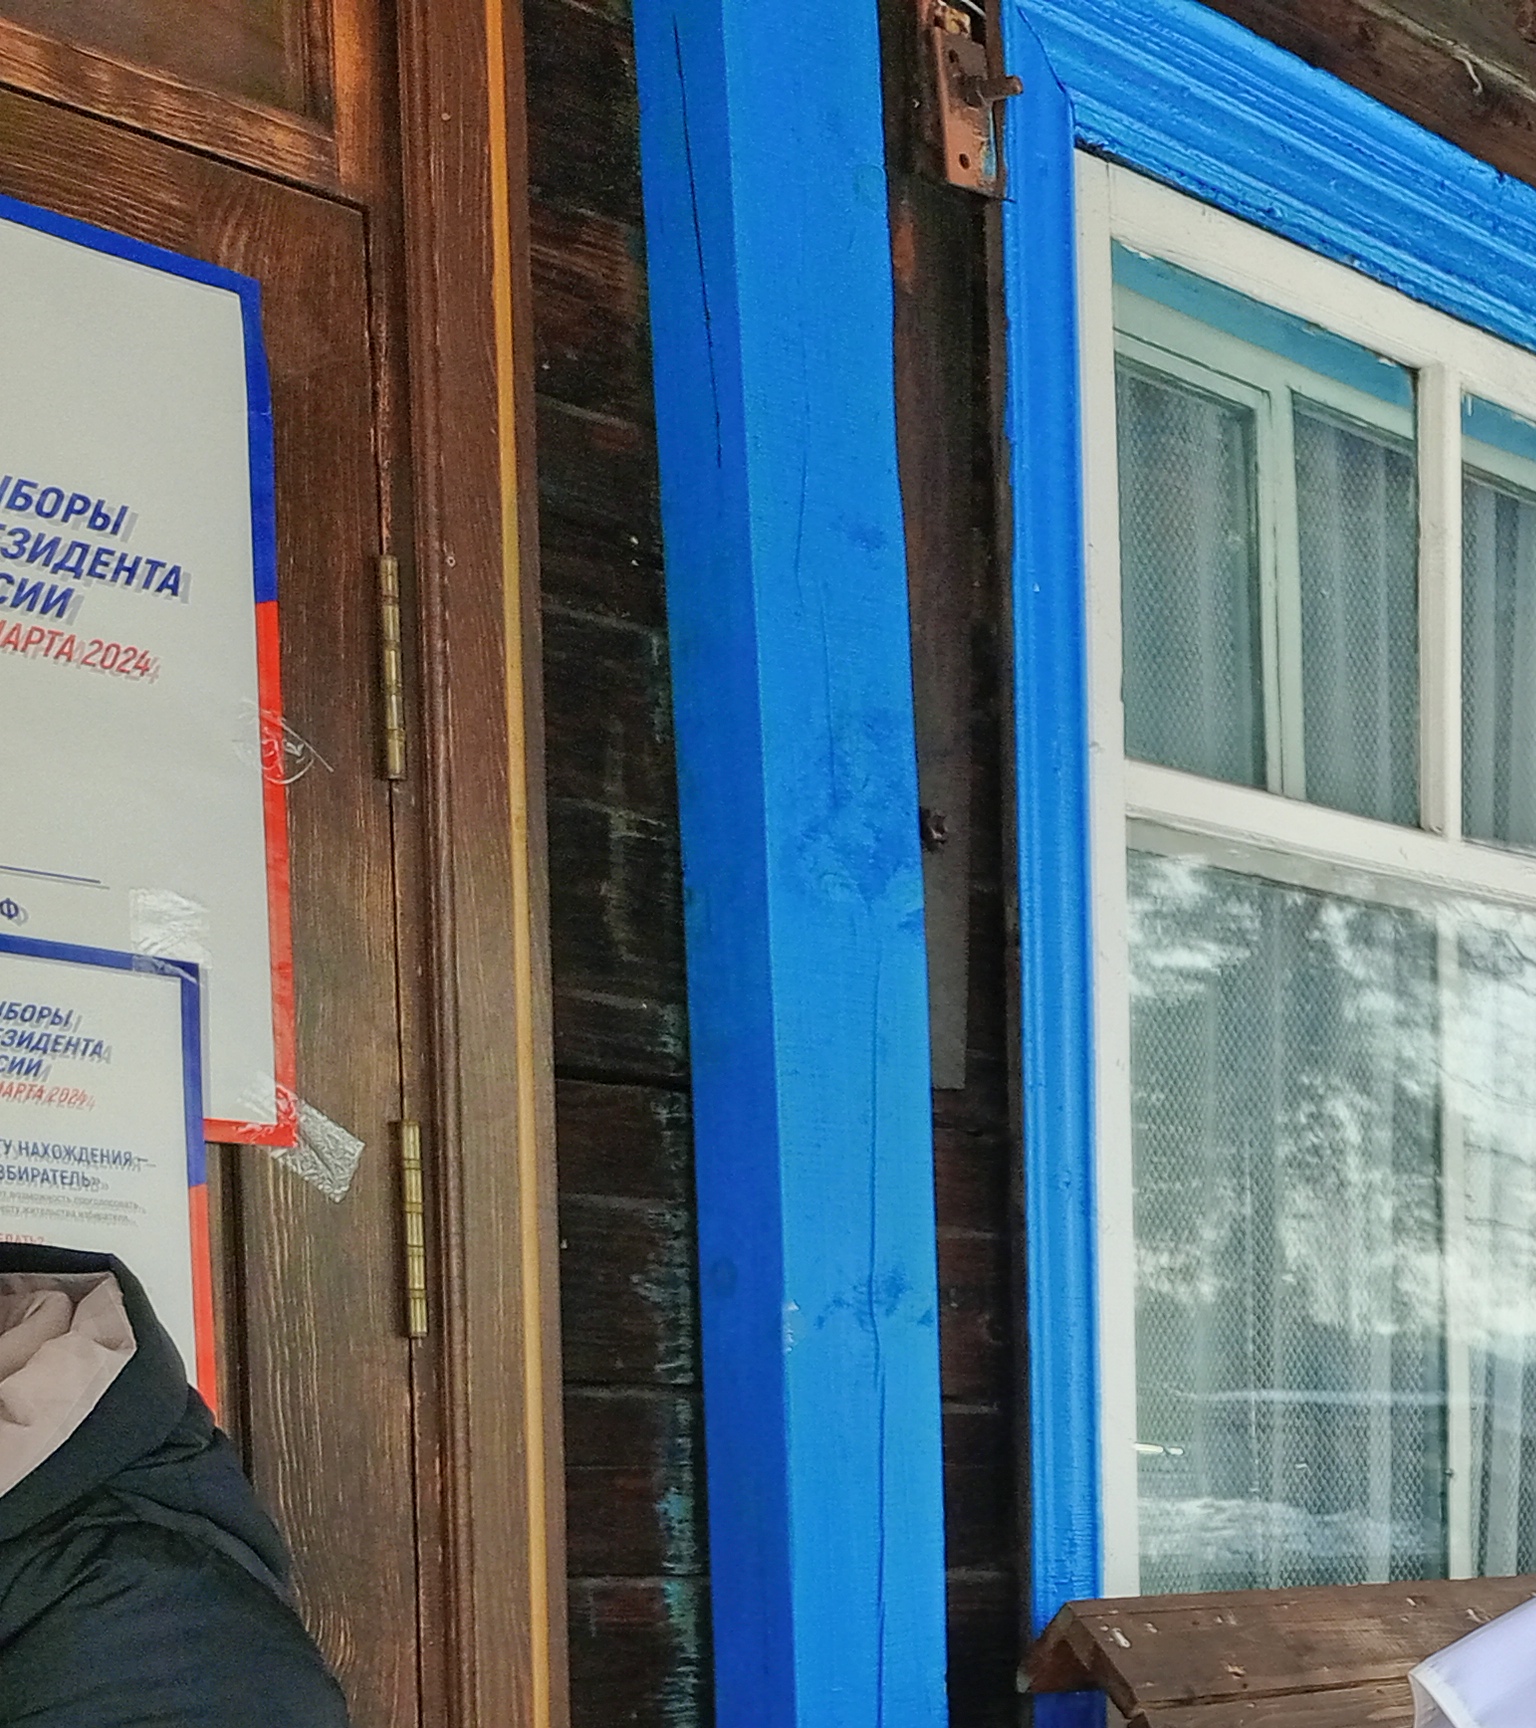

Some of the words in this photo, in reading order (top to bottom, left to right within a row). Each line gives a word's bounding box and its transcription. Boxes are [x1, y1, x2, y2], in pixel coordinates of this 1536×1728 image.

[0, 524, 182, 597] ЗИДЕНТА
[81, 639, 152, 677] 2024
[0, 1027, 104, 1059] ЗИДЕНТА
[47, 1086, 89, 1105] 2024
[18, 1140, 133, 1166] НАХОЖДЕНИЯ
